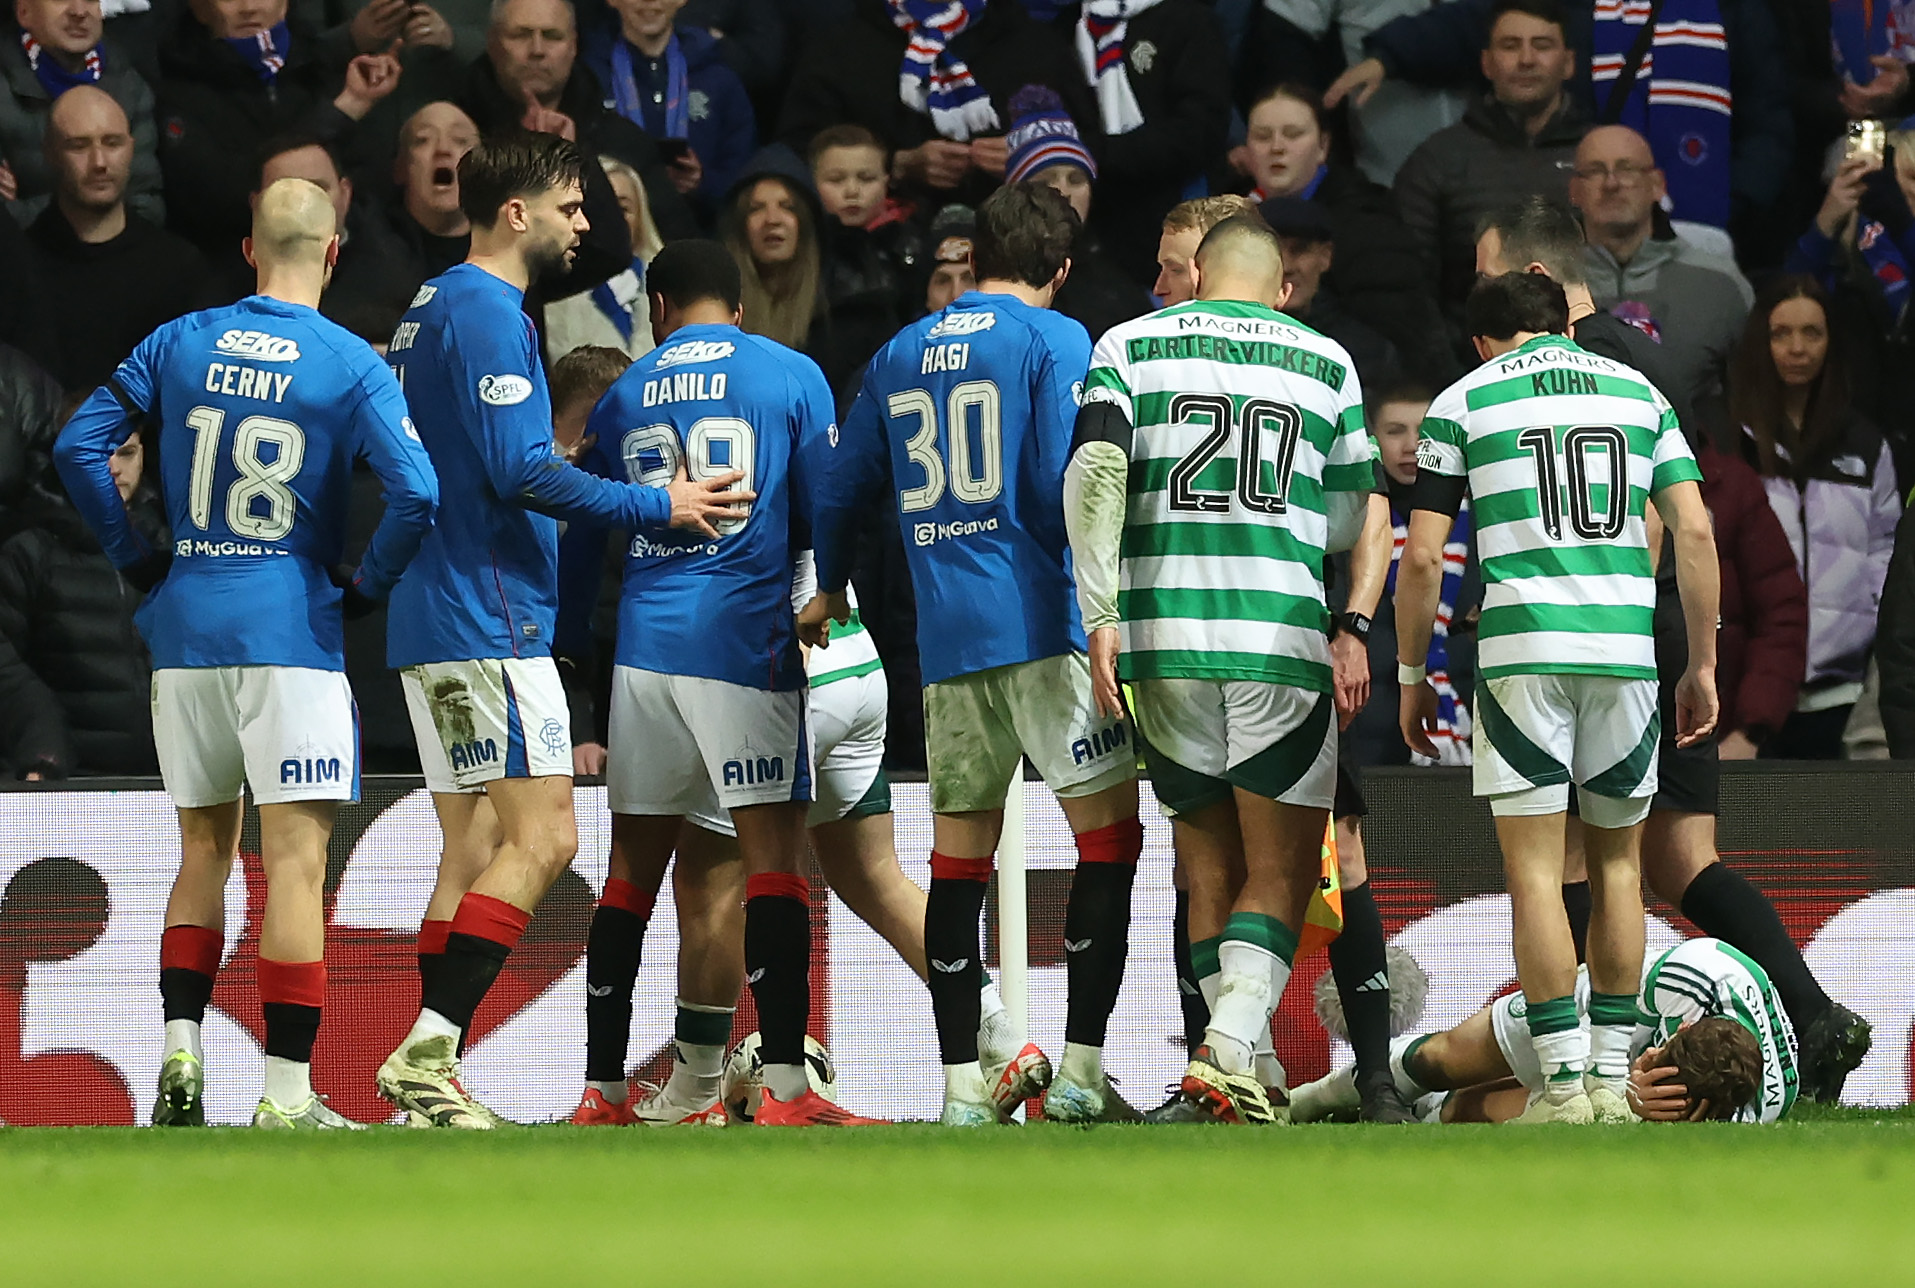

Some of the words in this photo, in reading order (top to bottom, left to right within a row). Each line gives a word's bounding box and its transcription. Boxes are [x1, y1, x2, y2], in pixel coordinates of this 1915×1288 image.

[215, 329, 300, 356] SEKO
[1178, 315, 1300, 342] MAGNERS
[656, 340, 735, 367] SEKO
[920, 342, 970, 375] HAGI
[1129, 334, 1343, 395] CARTER-VICKERS
[1501, 350, 1617, 375] MAGNERS
[205, 362, 294, 403] CERNY
[494, 383, 522, 396] SPFL
[642, 372, 727, 408] DANILO
[888, 379, 1003, 513] 30
[1167, 392, 1303, 515] 20
[185, 405, 306, 541] 18
[1517, 425, 1629, 543] 10
[451, 738, 499, 771] AIM
[1072, 722, 1127, 765] AIM
[281, 758, 340, 784] AIM
[723, 755, 784, 786] AIM
[1742, 985, 1781, 1107] MAGNERS
